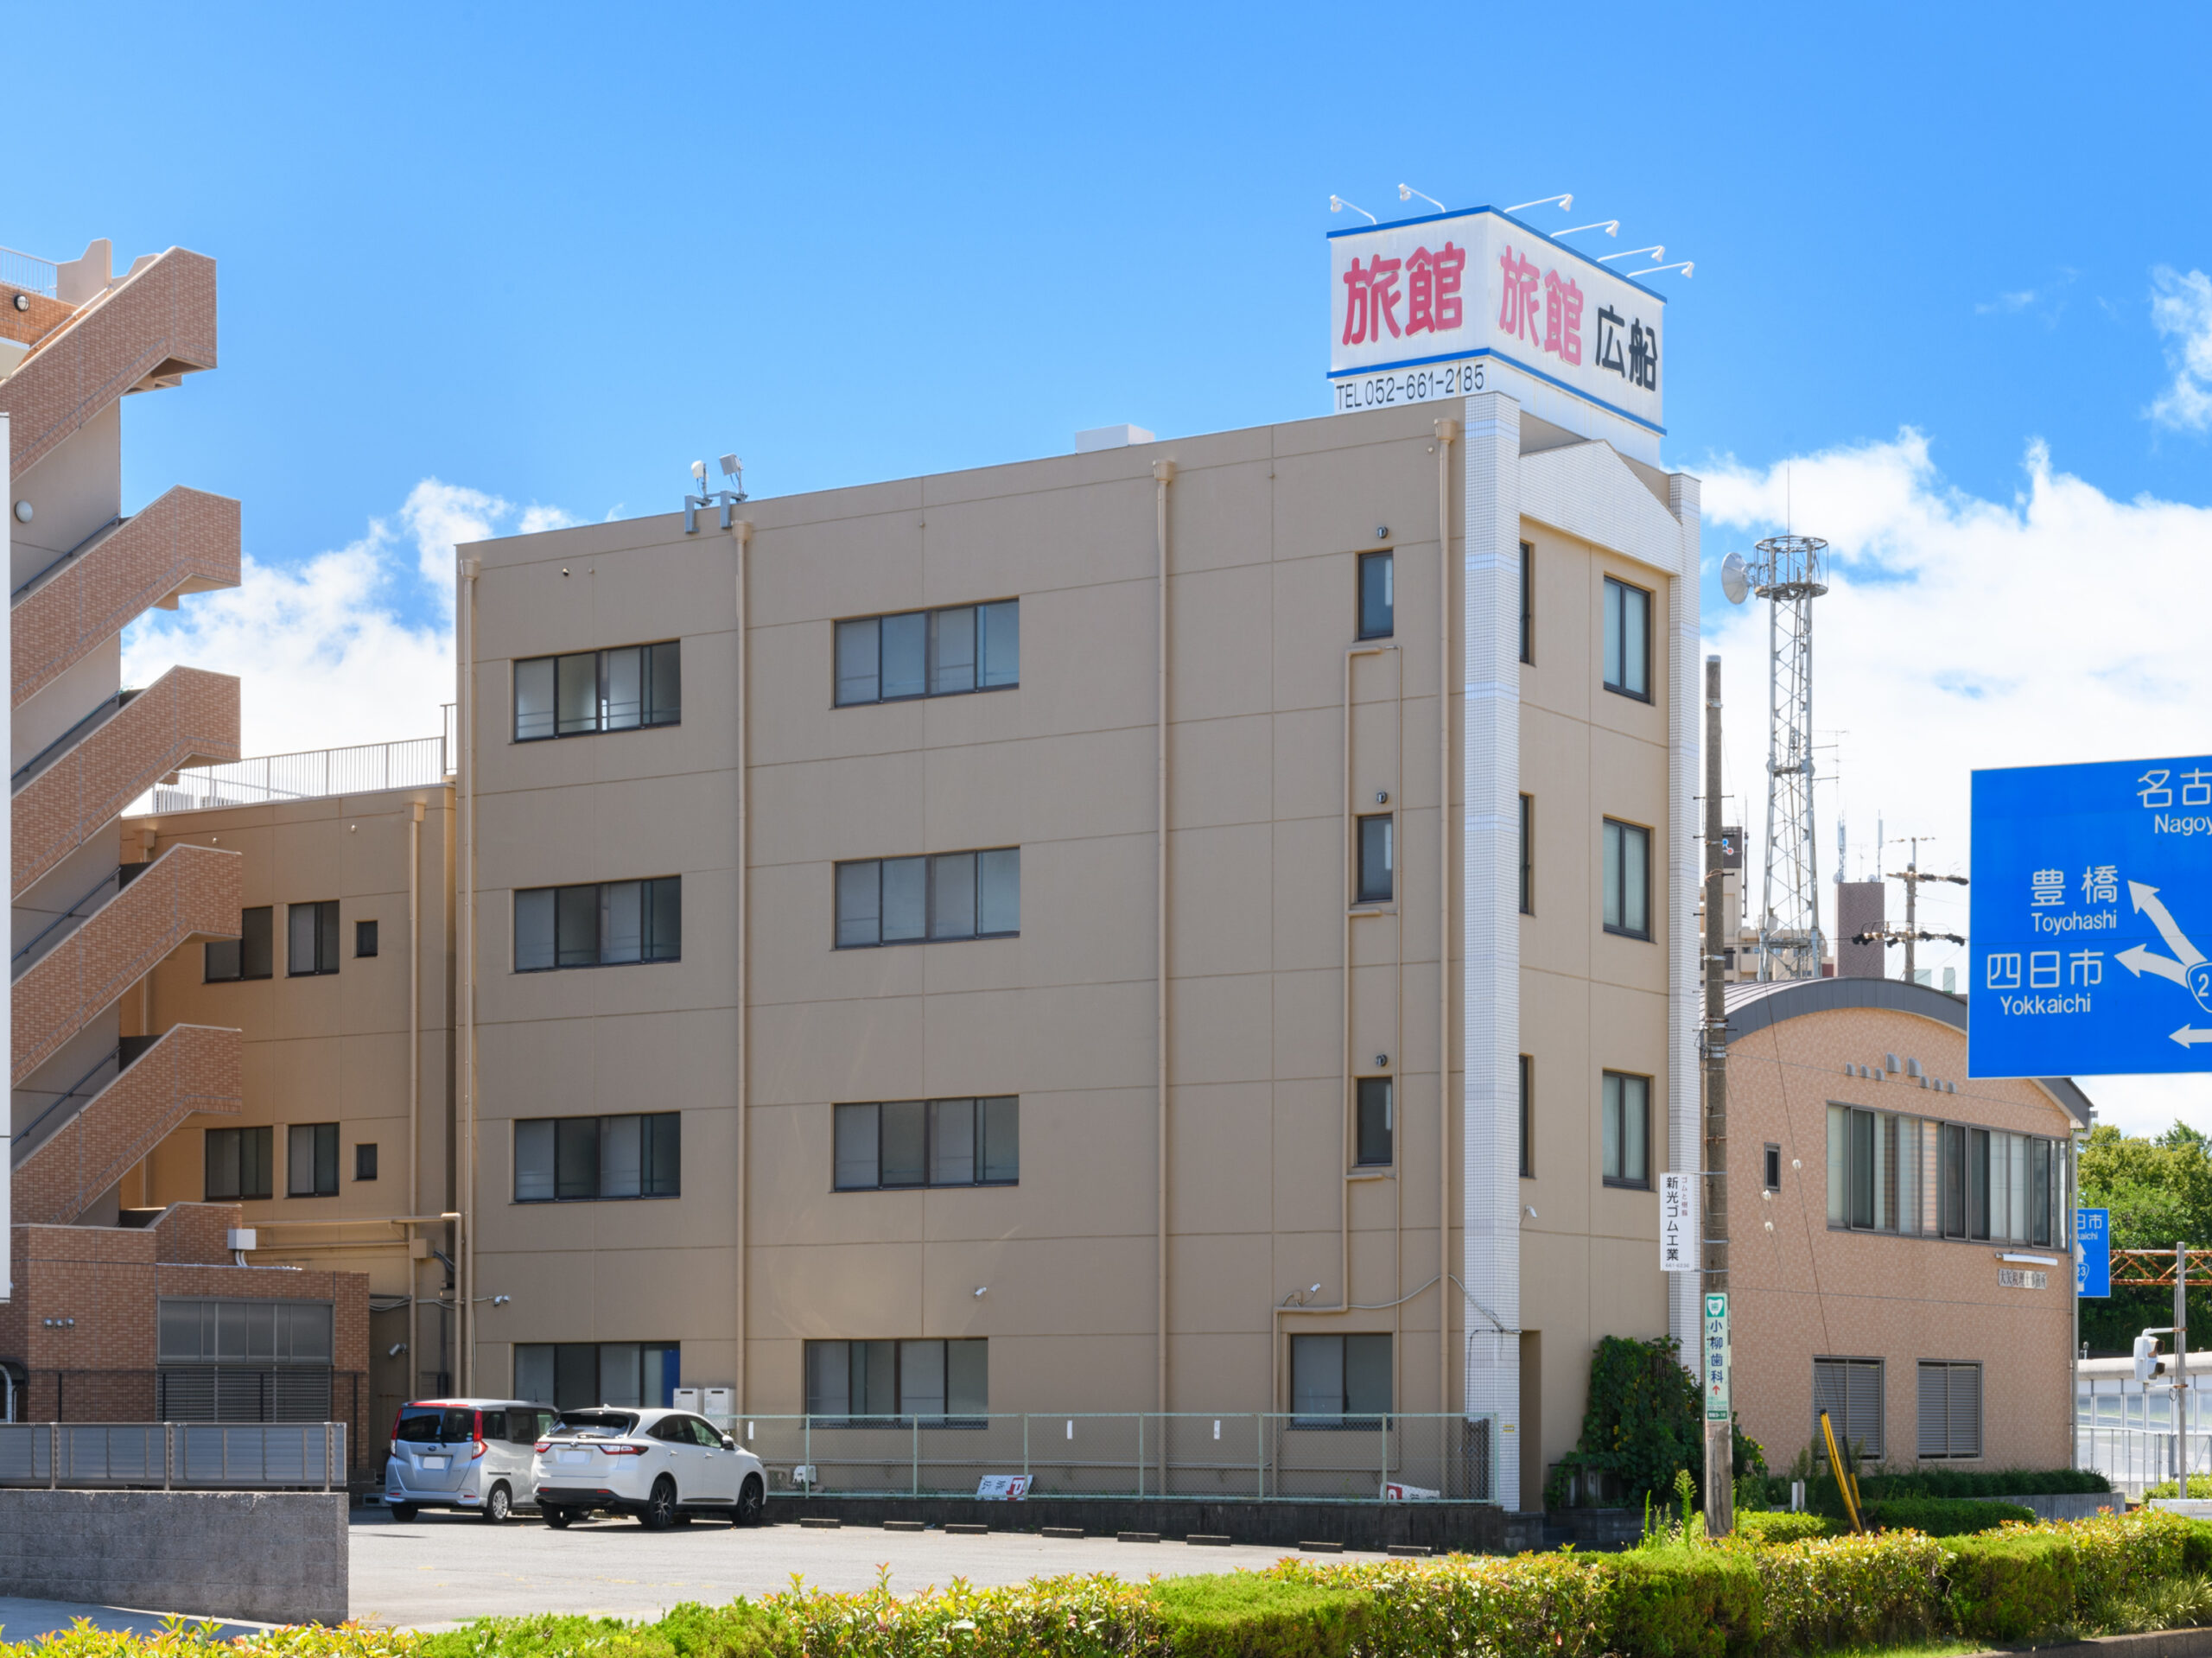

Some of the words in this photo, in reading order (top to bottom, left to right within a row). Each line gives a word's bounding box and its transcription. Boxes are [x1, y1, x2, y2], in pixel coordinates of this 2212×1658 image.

[1342, 241, 1465, 346] 旅館
[1499, 245, 1584, 367] 旅館
[1595, 304, 1657, 392] 広船
[1365, 364, 1484, 406] 052-661-2185
[2137, 767, 2212, 809] 名古
[2031, 864, 2119, 907] 豊橋
[2031, 909, 2118, 936] Toyohashi
[1986, 948, 2104, 990] 四日市
[2000, 993, 2091, 1016] Yokkaichi
[1666, 1176, 1679, 1261] 新光ゴム工業
[1710, 1319, 1724, 1383] 小柳歯科
